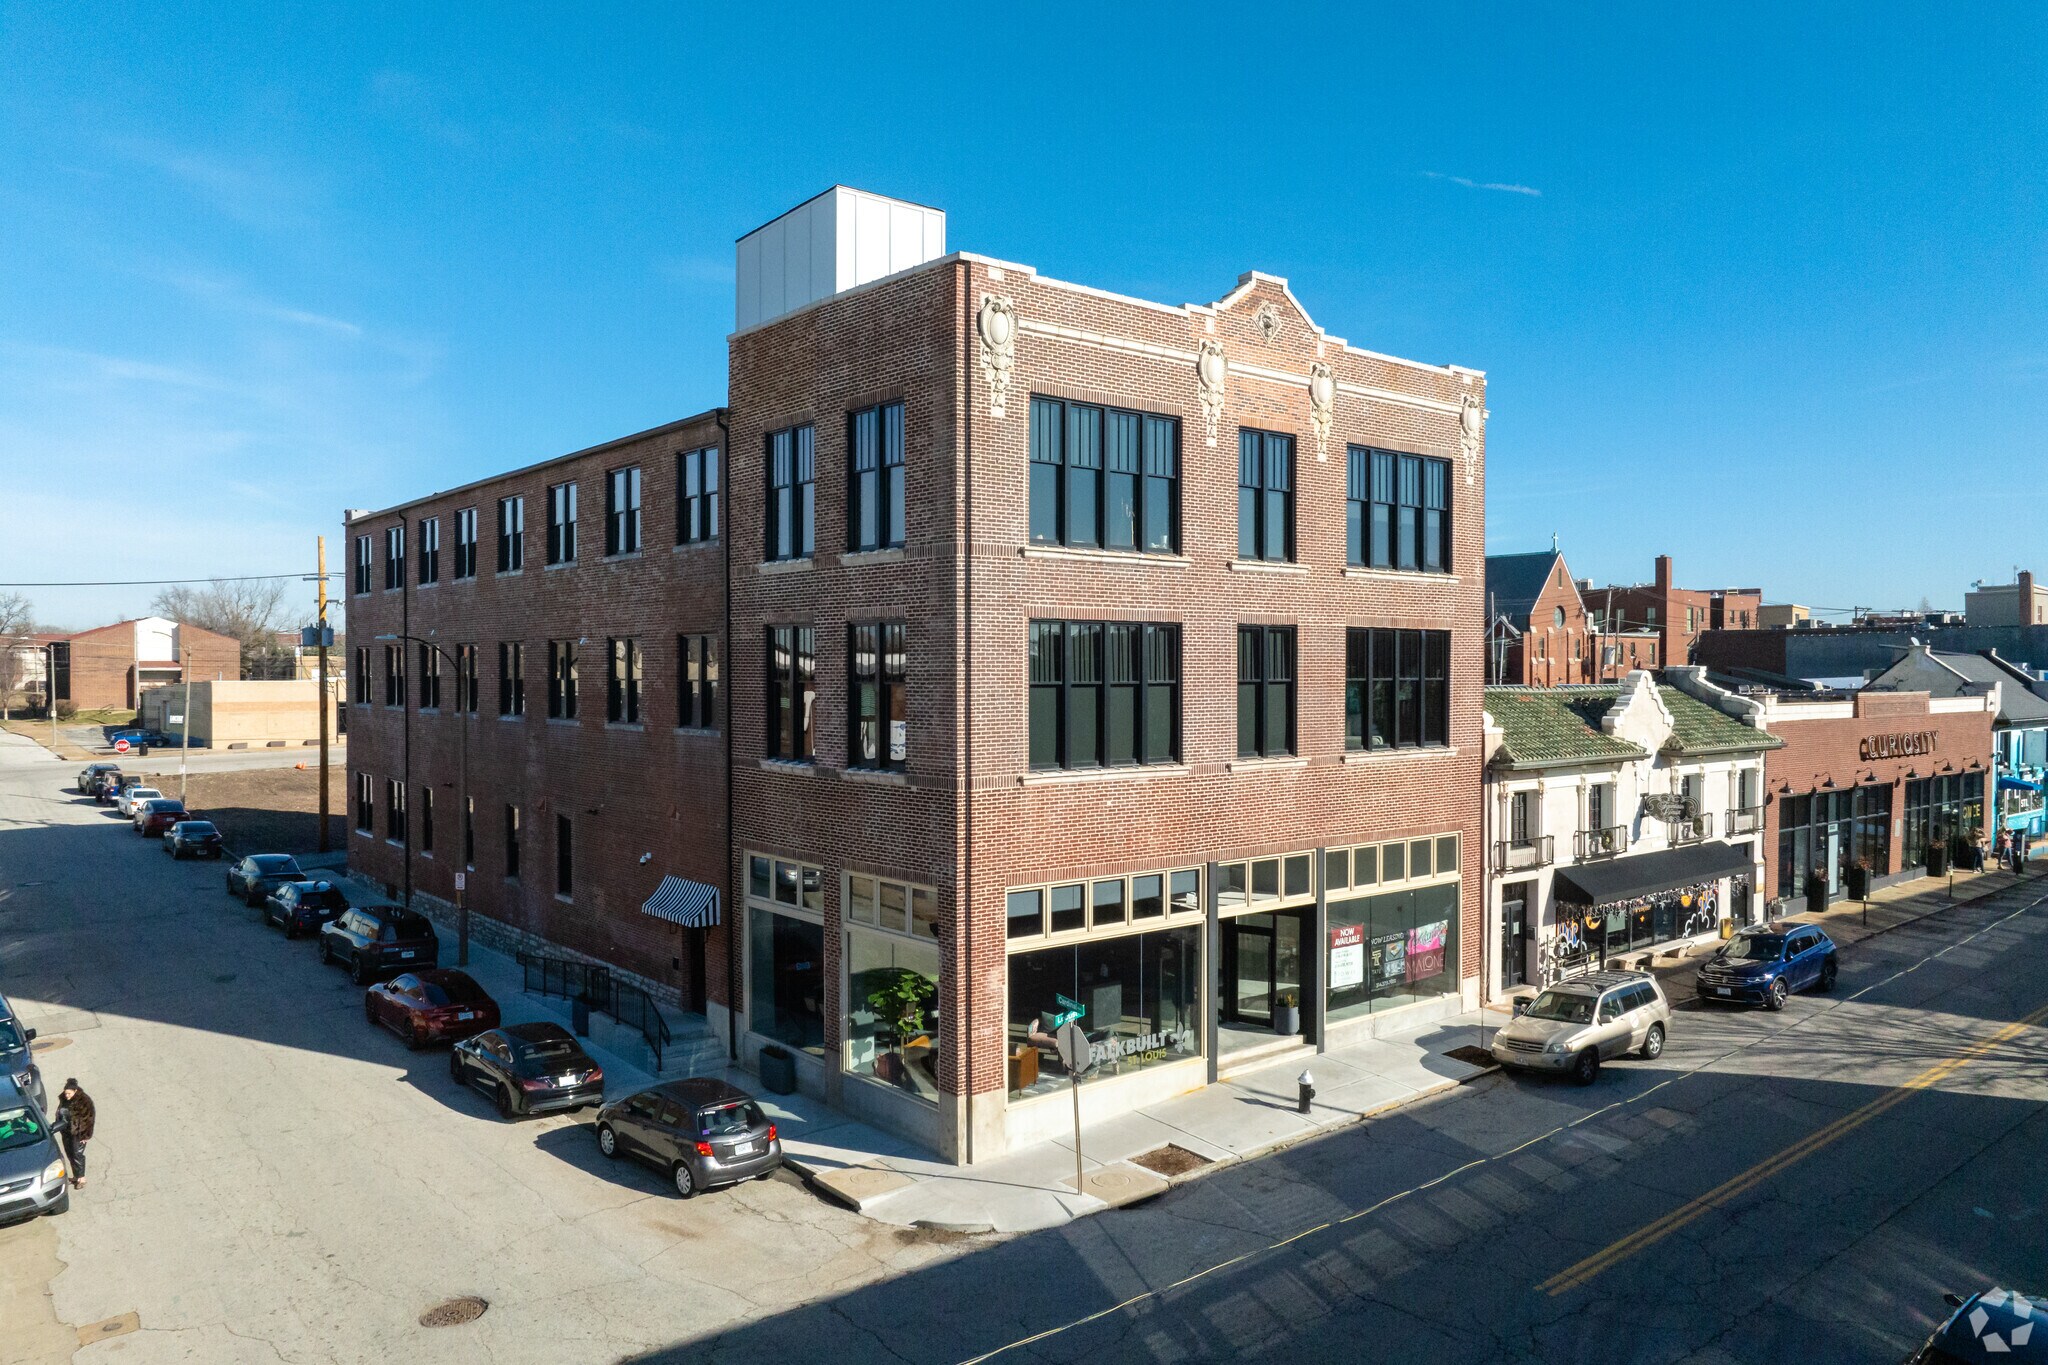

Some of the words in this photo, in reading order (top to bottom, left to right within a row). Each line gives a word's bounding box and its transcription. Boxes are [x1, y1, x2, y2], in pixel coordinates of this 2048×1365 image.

[1866, 729, 1939, 758] CURIOSITY
[1340, 927, 1355, 938] NOW
[1371, 937, 1383, 945] NOW
[1383, 932, 1405, 943] LEASING
[1334, 934, 1360, 947] AVAILABLE
[1089, 1031, 1167, 1063] FALKBUILT
[1127, 1055, 1139, 1066] ST.
[1141, 1048, 1167, 1063] LOUIS
